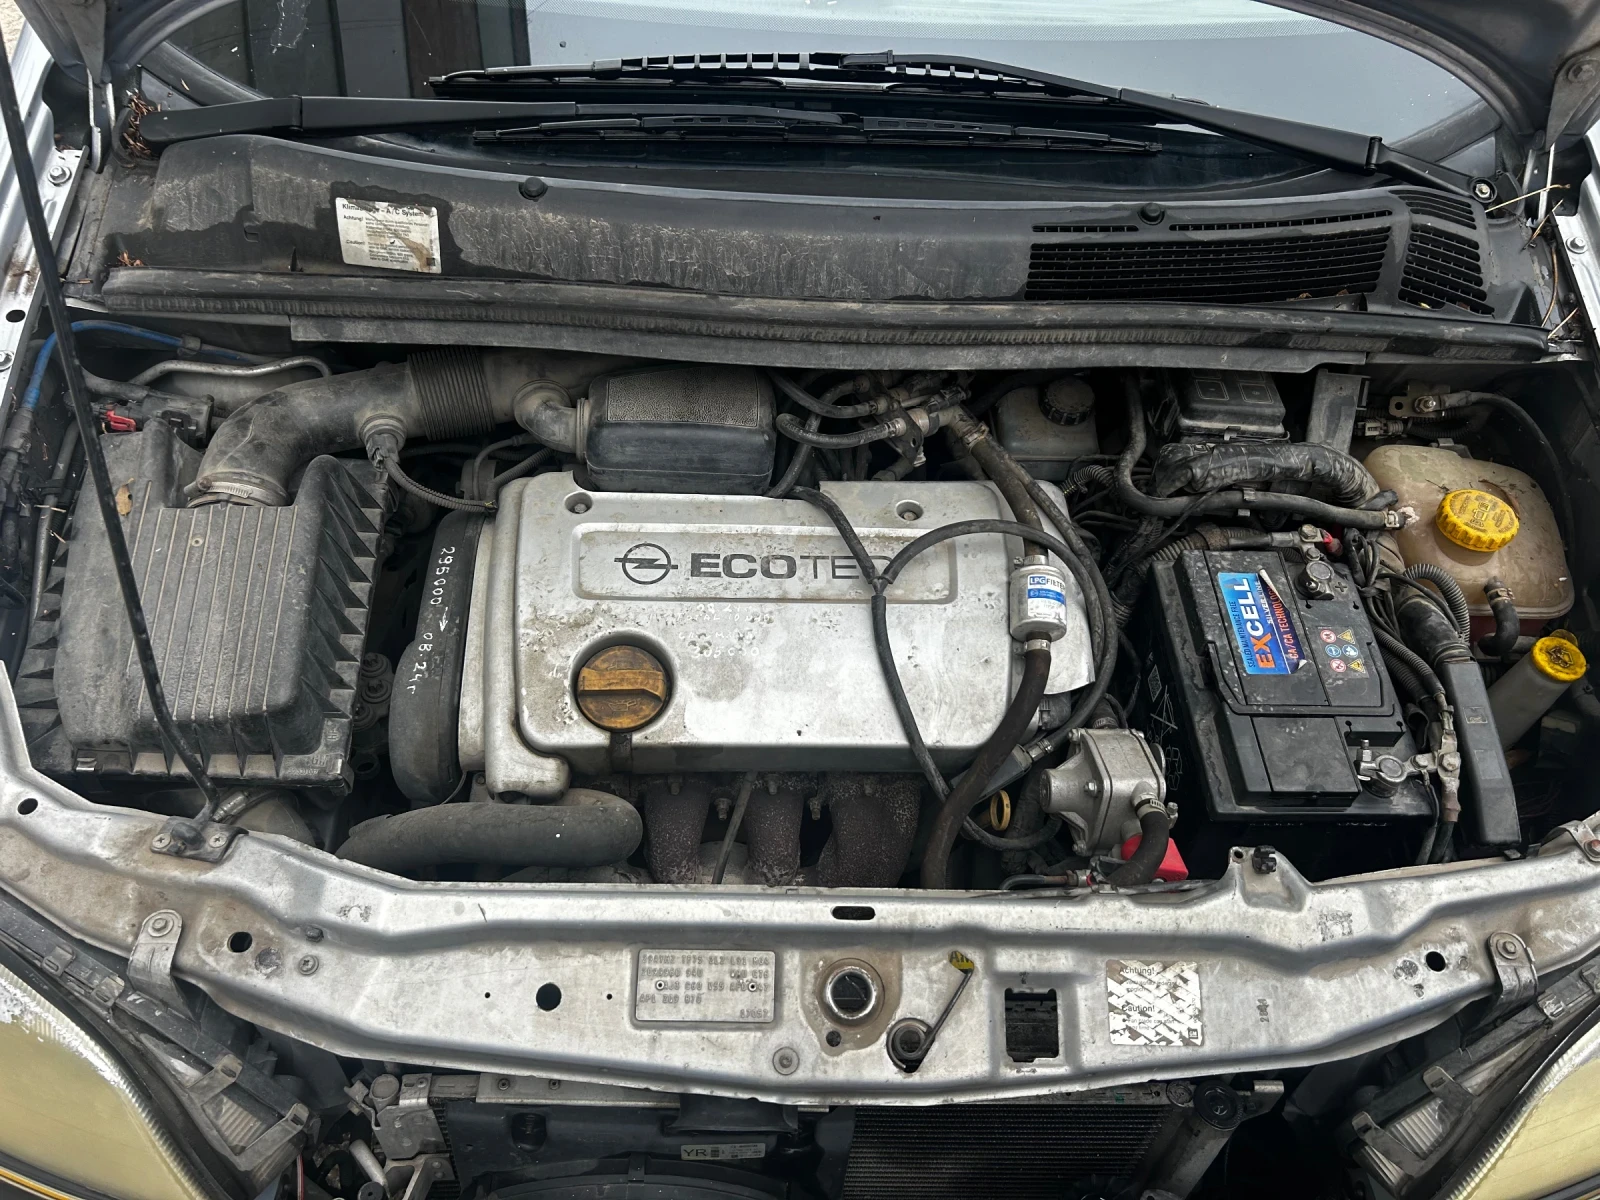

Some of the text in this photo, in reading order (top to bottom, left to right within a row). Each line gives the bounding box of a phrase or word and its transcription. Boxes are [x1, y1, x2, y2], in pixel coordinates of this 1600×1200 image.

[402, 209, 424, 217] System
[430, 546, 456, 605] 295000
[690, 552, 892, 580] ECOTE
[1030, 576, 1045, 584] LPG
[1255, 579, 1274, 624] SILVER LINE
[1229, 601, 1255, 667] SEALED MAINTENANCE FREE
[1233, 578, 1276, 668] EXCELL
[1283, 633, 1299, 659] CA/CA
[1120, 967, 1155, 976] Achtung!
[683, 1148, 707, 1157] YR
